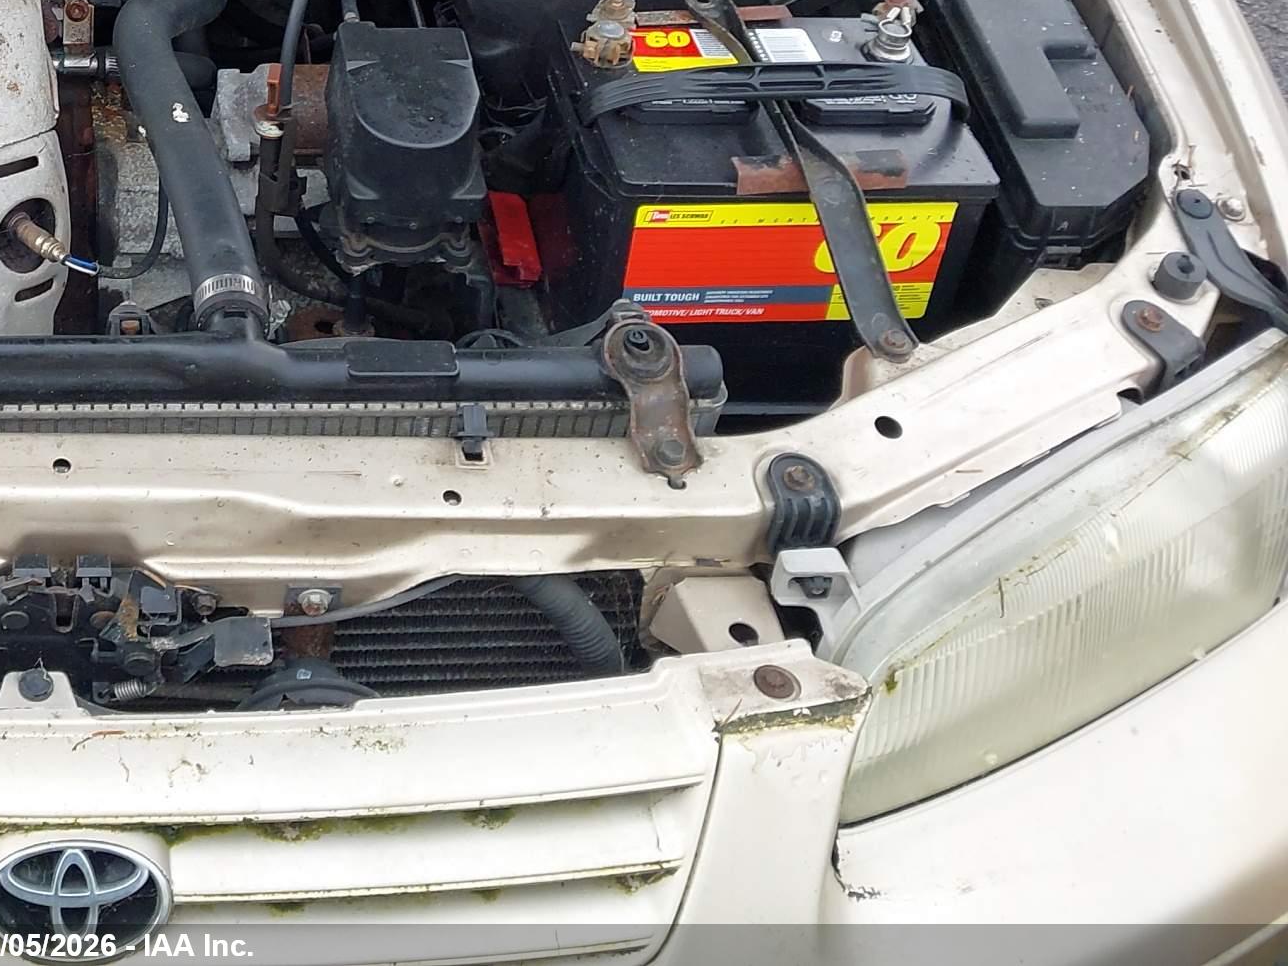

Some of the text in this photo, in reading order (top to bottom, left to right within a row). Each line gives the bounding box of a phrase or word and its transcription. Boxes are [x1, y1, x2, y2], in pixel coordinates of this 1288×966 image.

[645, 30, 691, 48] 60
[633, 293, 663, 302] BUILT
[664, 292, 700, 302] TOUGH
[644, 307, 765, 317] OMOTIVE/LIGHT TRUCK/VAN
